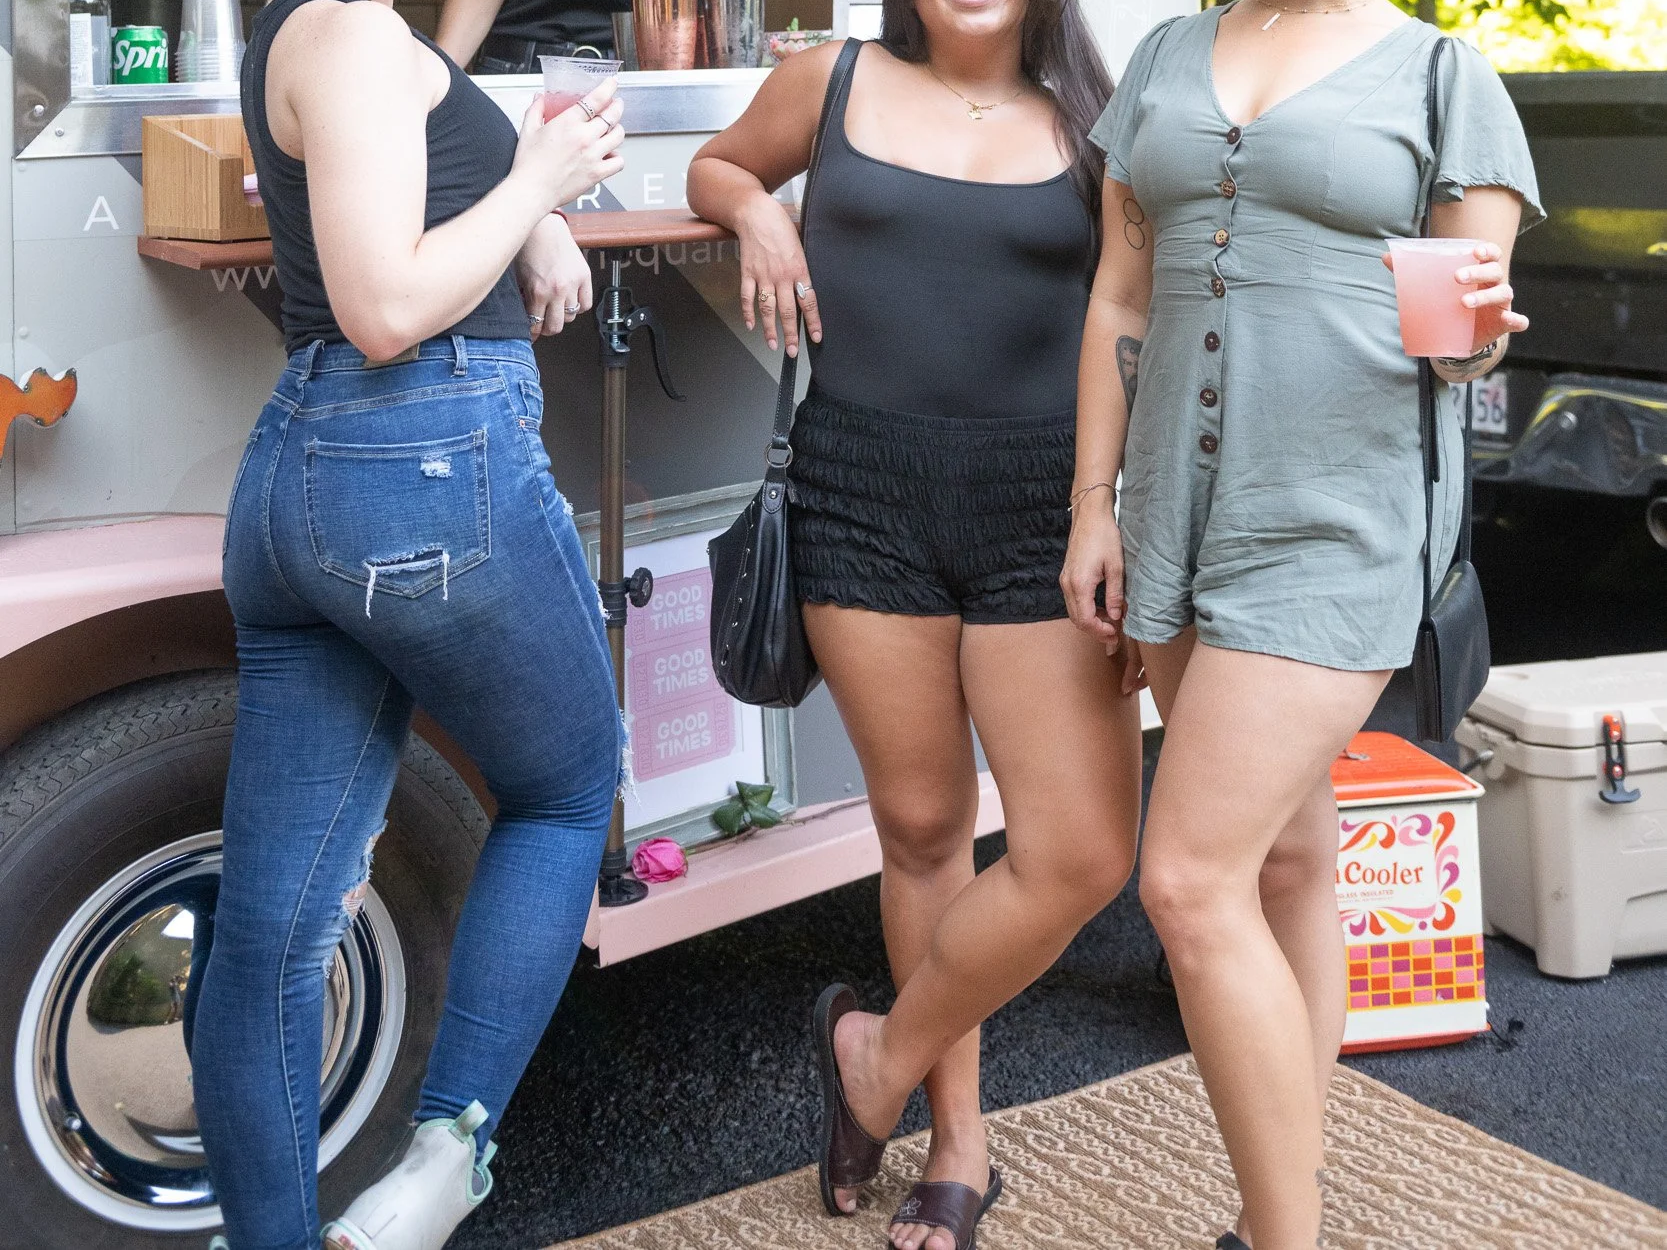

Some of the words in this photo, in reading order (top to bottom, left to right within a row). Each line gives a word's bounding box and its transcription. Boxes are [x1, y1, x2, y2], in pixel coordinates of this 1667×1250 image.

[652, 585, 701, 611] GOOD
[650, 603, 705, 630] TIMES
[655, 648, 704, 676] GOOD
[653, 667, 708, 695] TIMES
[658, 711, 707, 740] GOOD
[656, 729, 711, 759] TIMES
[1344, 861, 1424, 886] Cooler
